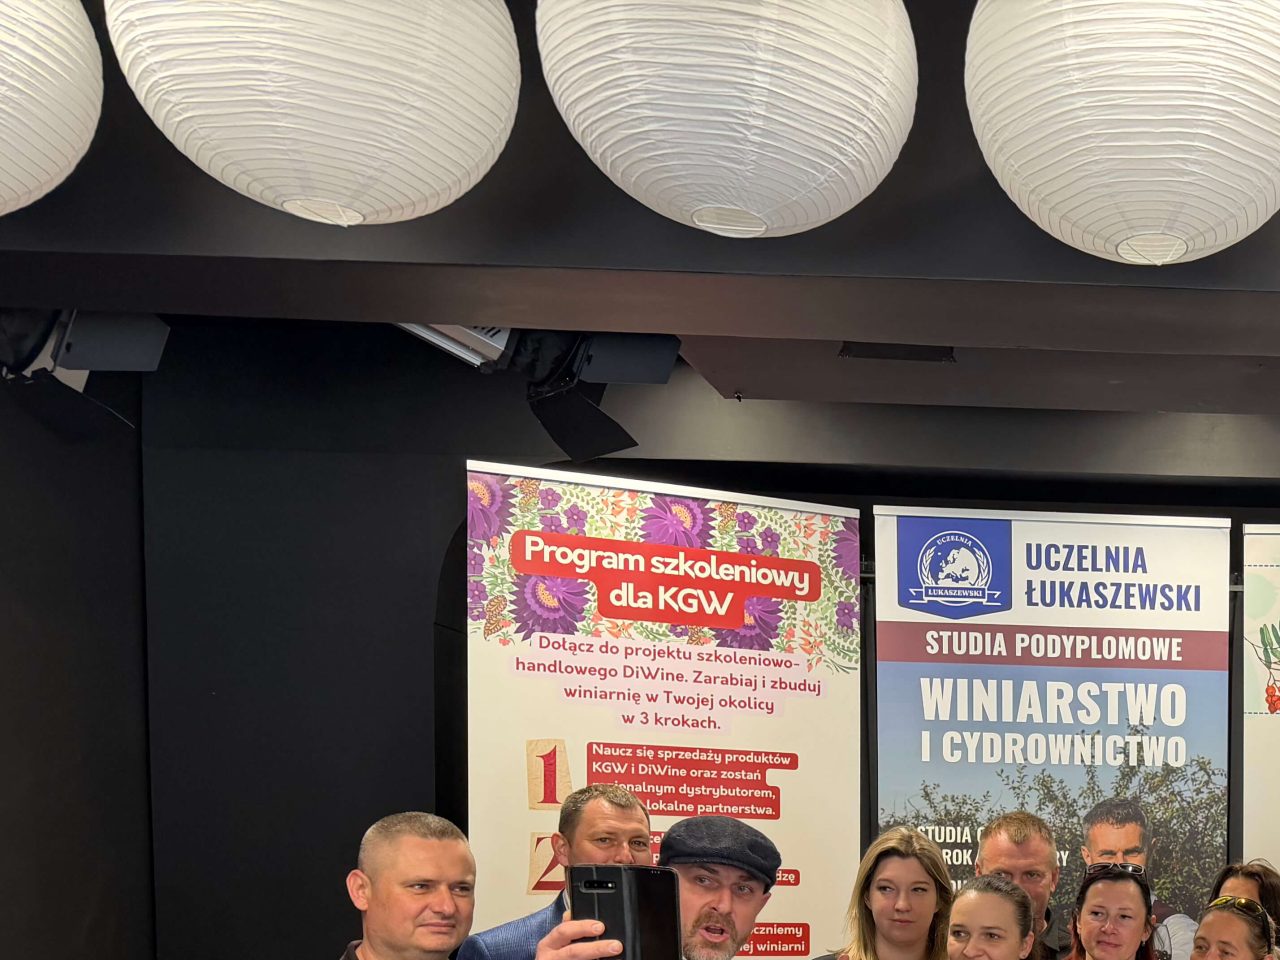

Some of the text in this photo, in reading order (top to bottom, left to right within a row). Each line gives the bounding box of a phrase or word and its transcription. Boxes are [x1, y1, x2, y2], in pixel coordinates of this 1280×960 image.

[937, 535, 972, 547] UCZELNIA
[525, 535, 810, 595] Program szkoleniowy
[1025, 542, 1147, 574] UCZELNIA
[609, 581, 734, 616] dla KGW
[1025, 580, 1201, 612] ŁUKASZEWSKI
[538, 634, 801, 670] Dołącz do projektu szkoleniowo-
[925, 630, 1183, 662] STUDIA PODYPLOMOWE
[515, 657, 618, 683] handlowego
[623, 665, 688, 684] DiWine.
[693, 670, 758, 692] Zarabiaj
[770, 674, 822, 696] zbuduj
[563, 684, 775, 715] winiarnię w Twojej okolicy
[920, 677, 1187, 727] WINIARSTWO
[621, 712, 721, 730] w 3 krokach.
[592, 744, 791, 767] Naucz się sprzedaży produktów
[921, 730, 1187, 768] I CYDROWNICTWO
[535, 745, 560, 804] 1
[592, 762, 628, 775] KGW
[638, 764, 687, 777] DiWine
[690, 769, 718, 779] oraz
[720, 767, 762, 780] zostań
[678, 784, 776, 800] dystrybutorem,
[646, 800, 776, 817] lokalne partnerstwa.
[918, 826, 972, 843] STUDIA
[943, 848, 972, 865] ROK
[751, 924, 803, 938] czniemy
[756, 940, 806, 952] winiarni
